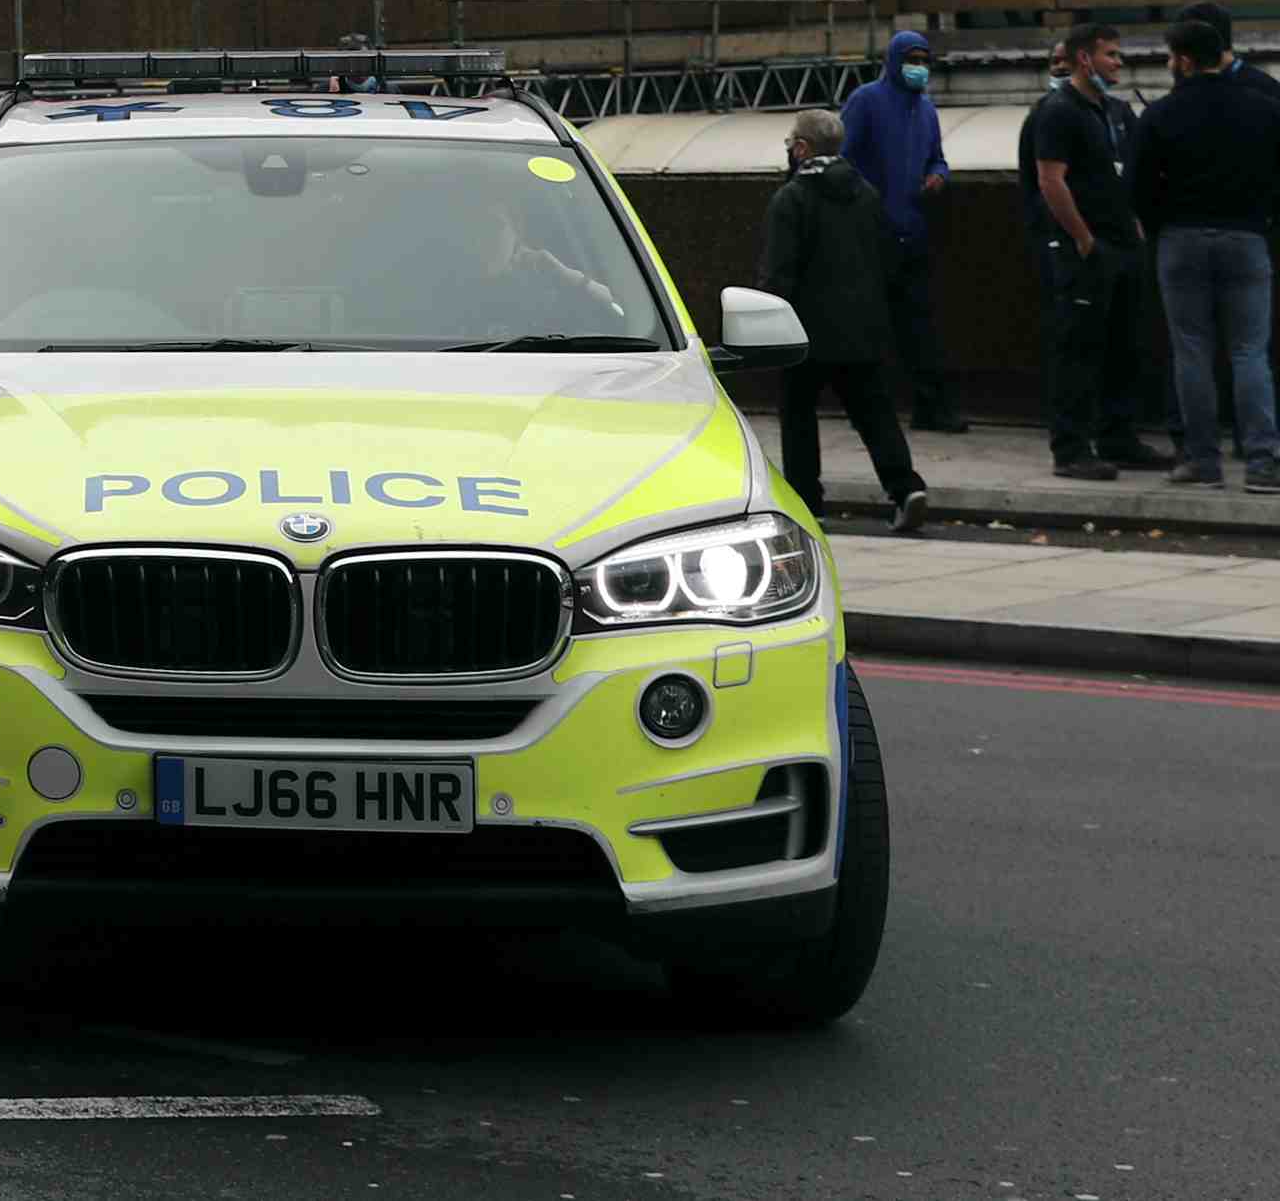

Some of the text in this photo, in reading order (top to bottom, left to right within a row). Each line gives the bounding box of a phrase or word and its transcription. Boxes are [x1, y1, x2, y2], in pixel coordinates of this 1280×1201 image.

[83, 469, 530, 517] POLICE
[161, 800, 180, 814] GB
[194, 766, 463, 822] LJ66 HNR
